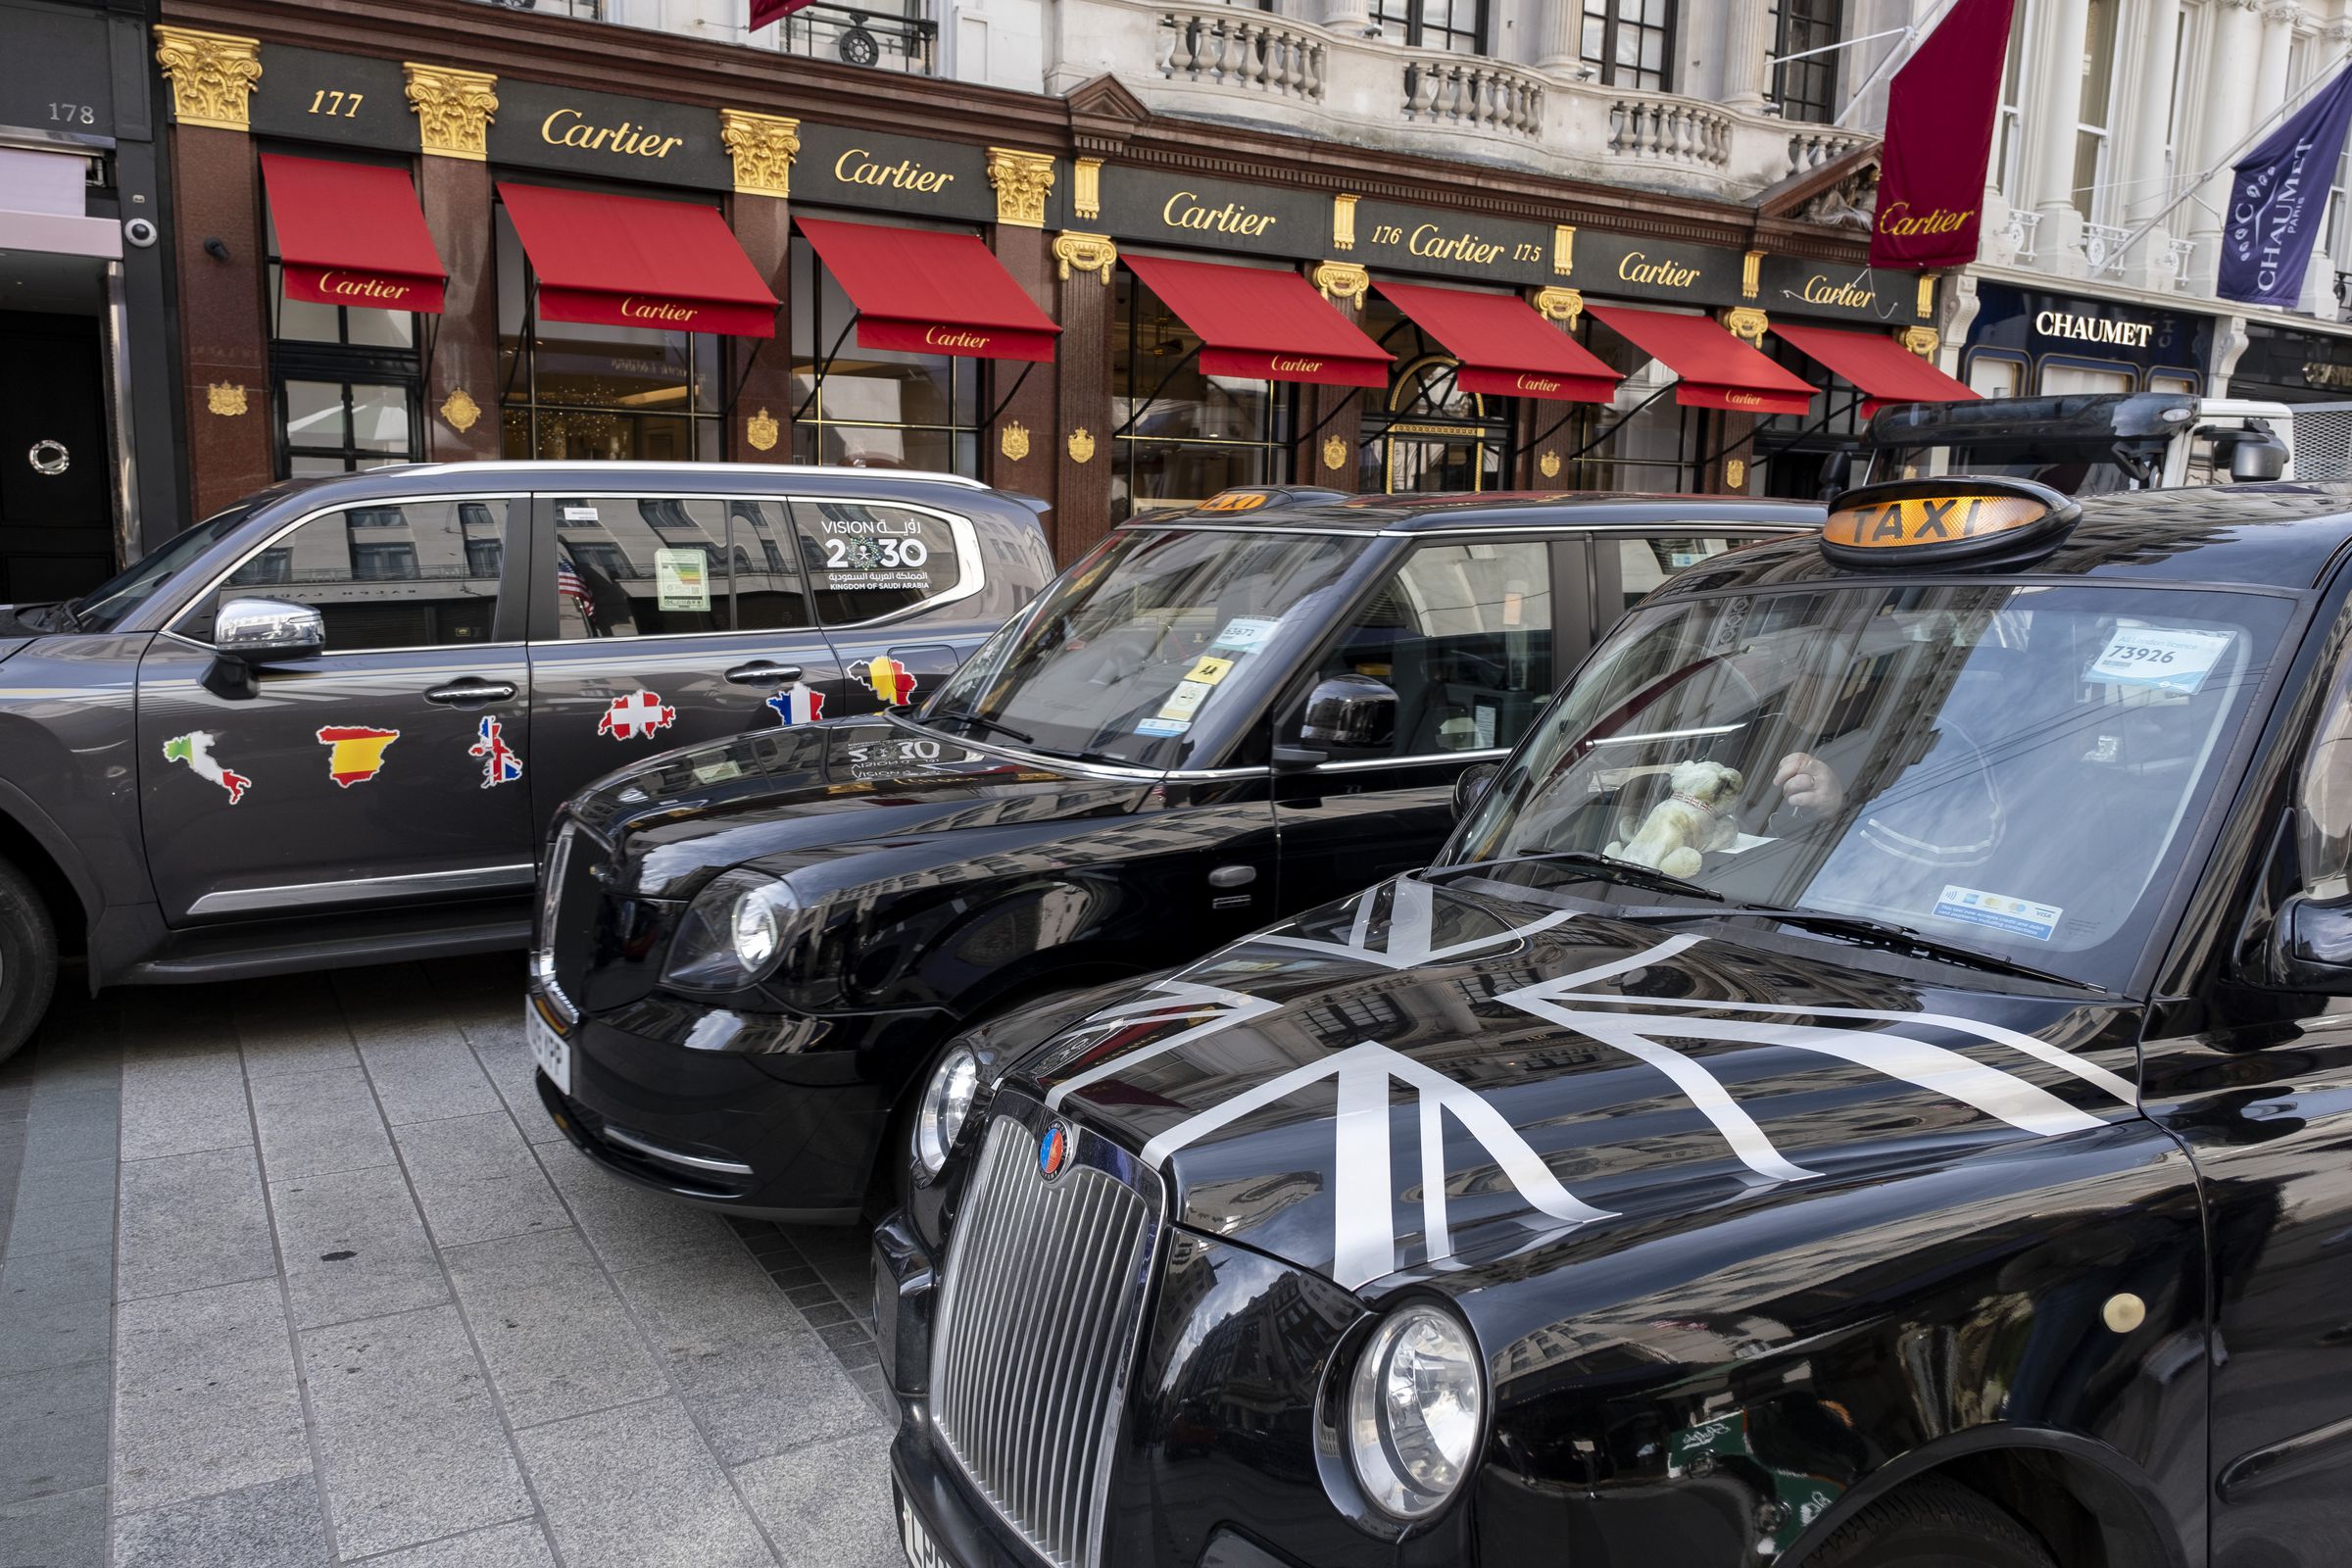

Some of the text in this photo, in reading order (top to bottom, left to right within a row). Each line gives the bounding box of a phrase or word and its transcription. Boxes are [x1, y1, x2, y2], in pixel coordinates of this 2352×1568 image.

[48, 102, 95, 124] 178
[308, 89, 364, 118] 177
[541, 109, 683, 158] Cartier
[834, 148, 955, 193] Cartier
[1162, 191, 1276, 236] Cartier
[1880, 202, 1975, 236] Cartier
[2257, 136, 2313, 292] CHAUMET
[1371, 223, 1542, 265] 176 Cartier 175
[1618, 252, 1701, 288] Cartier
[318, 271, 410, 299] Cartier
[1804, 275, 1876, 308] Cartier
[621, 297, 698, 321] Cartier
[925, 325, 990, 349] Cartier
[2035, 311, 2153, 348] CHAUMET
[1271, 355, 1322, 372] Cartier
[1516, 373, 1560, 392] Cartier
[1725, 389, 1763, 406] Cartier
[821, 520, 875, 534] VISION
[1852, 499, 1983, 543] TAXI
[828, 571, 928, 582] المملكة العربية السعودية
[2108, 645, 2176, 663] 73926
